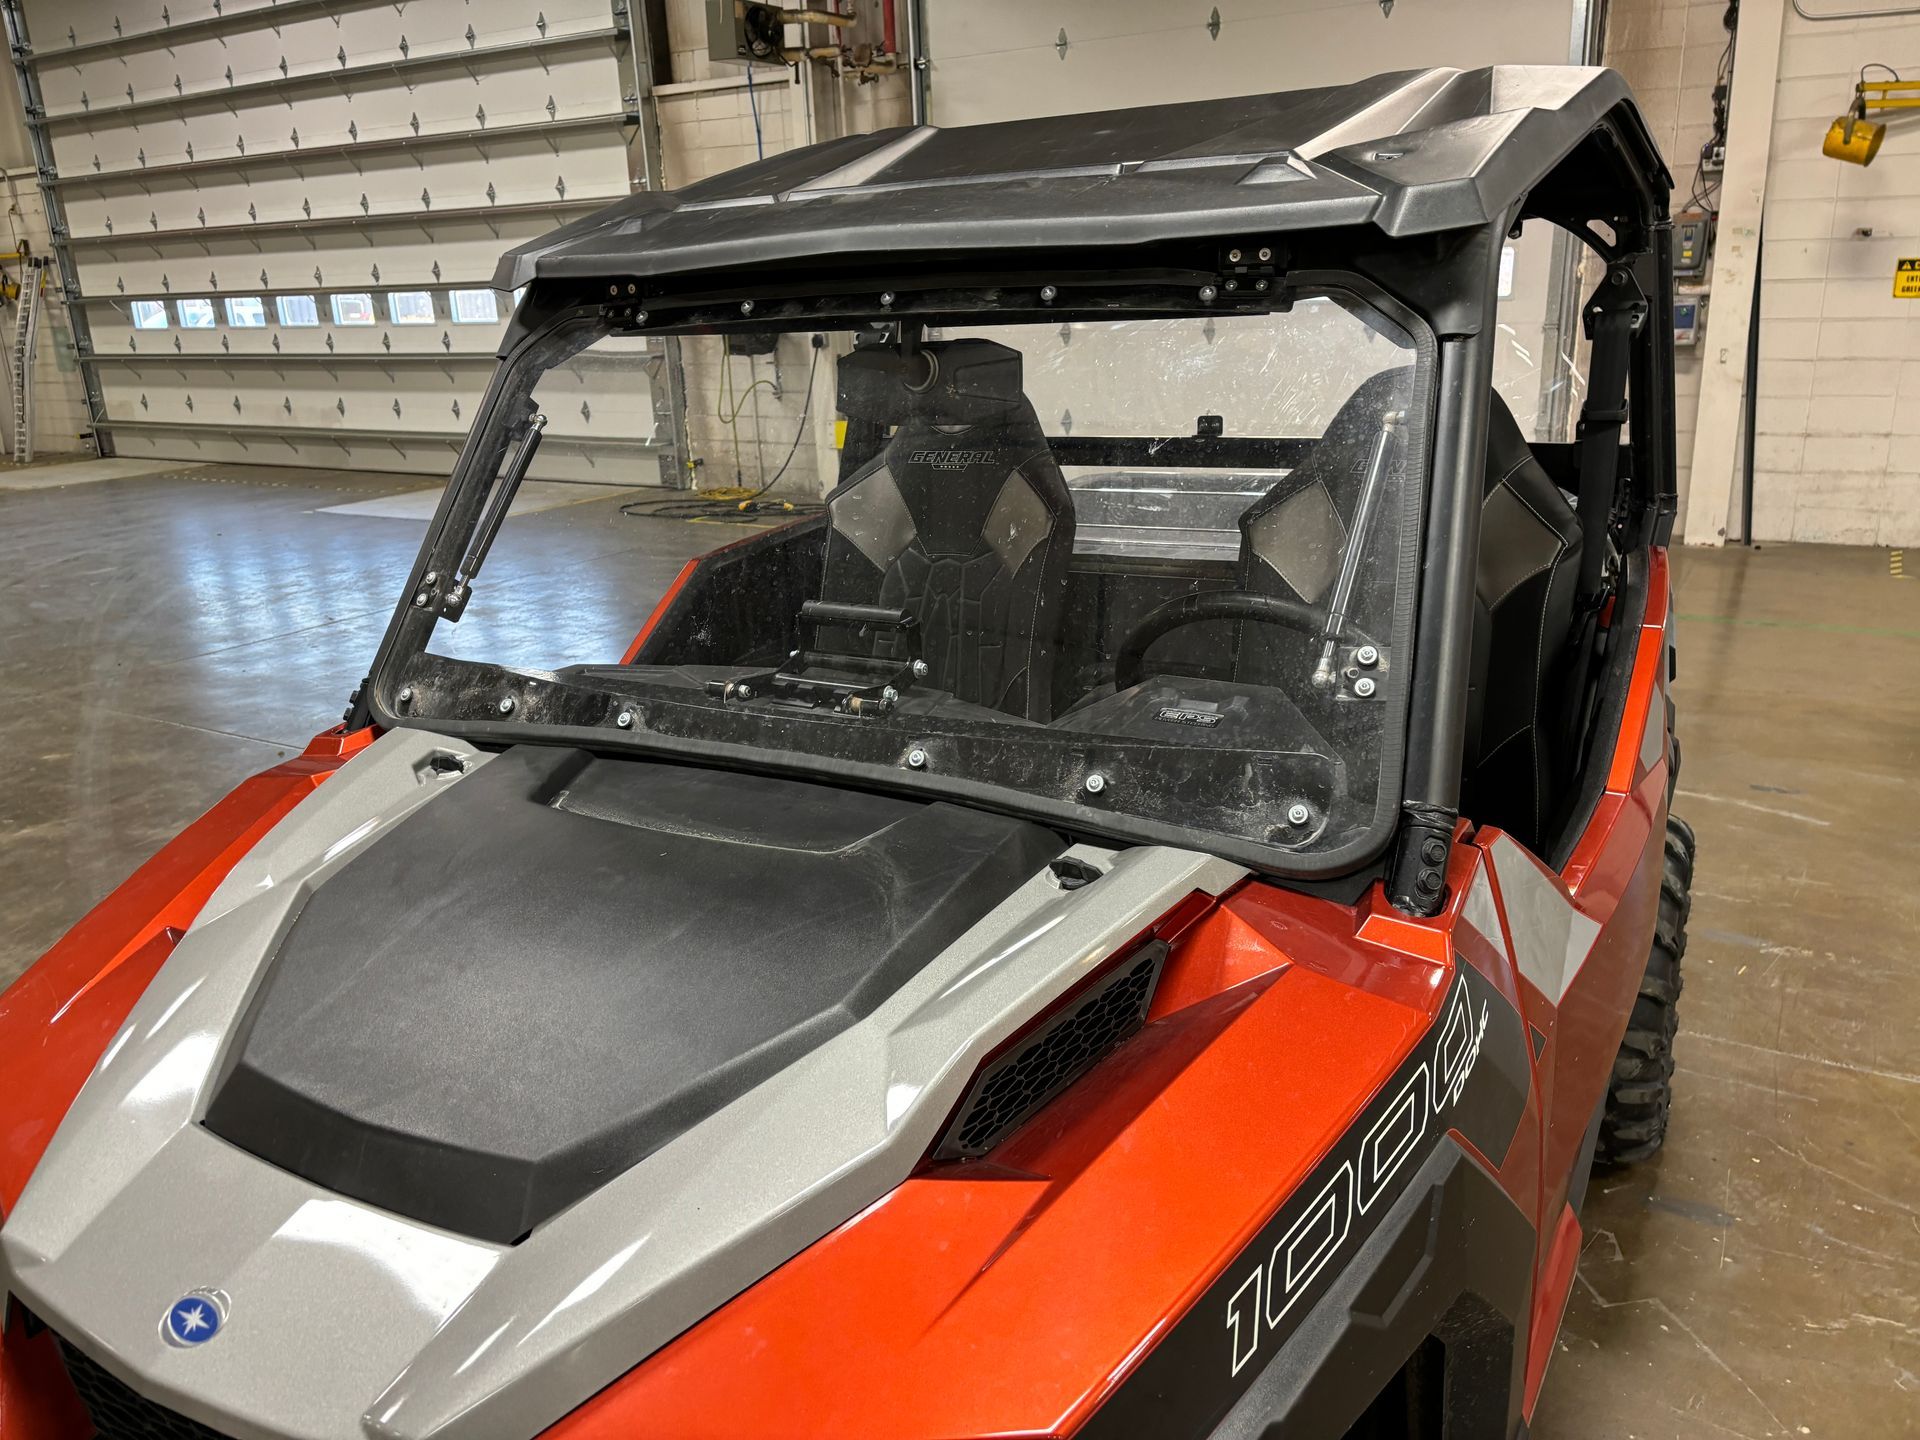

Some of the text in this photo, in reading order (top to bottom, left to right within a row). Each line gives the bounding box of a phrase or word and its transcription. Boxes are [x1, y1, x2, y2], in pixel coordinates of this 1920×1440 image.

[908, 451, 995, 464] GENERAL
[1159, 711, 1218, 724] EPS
[1453, 998, 1489, 1108] DOHC
[1227, 974, 1473, 1377] 1000
